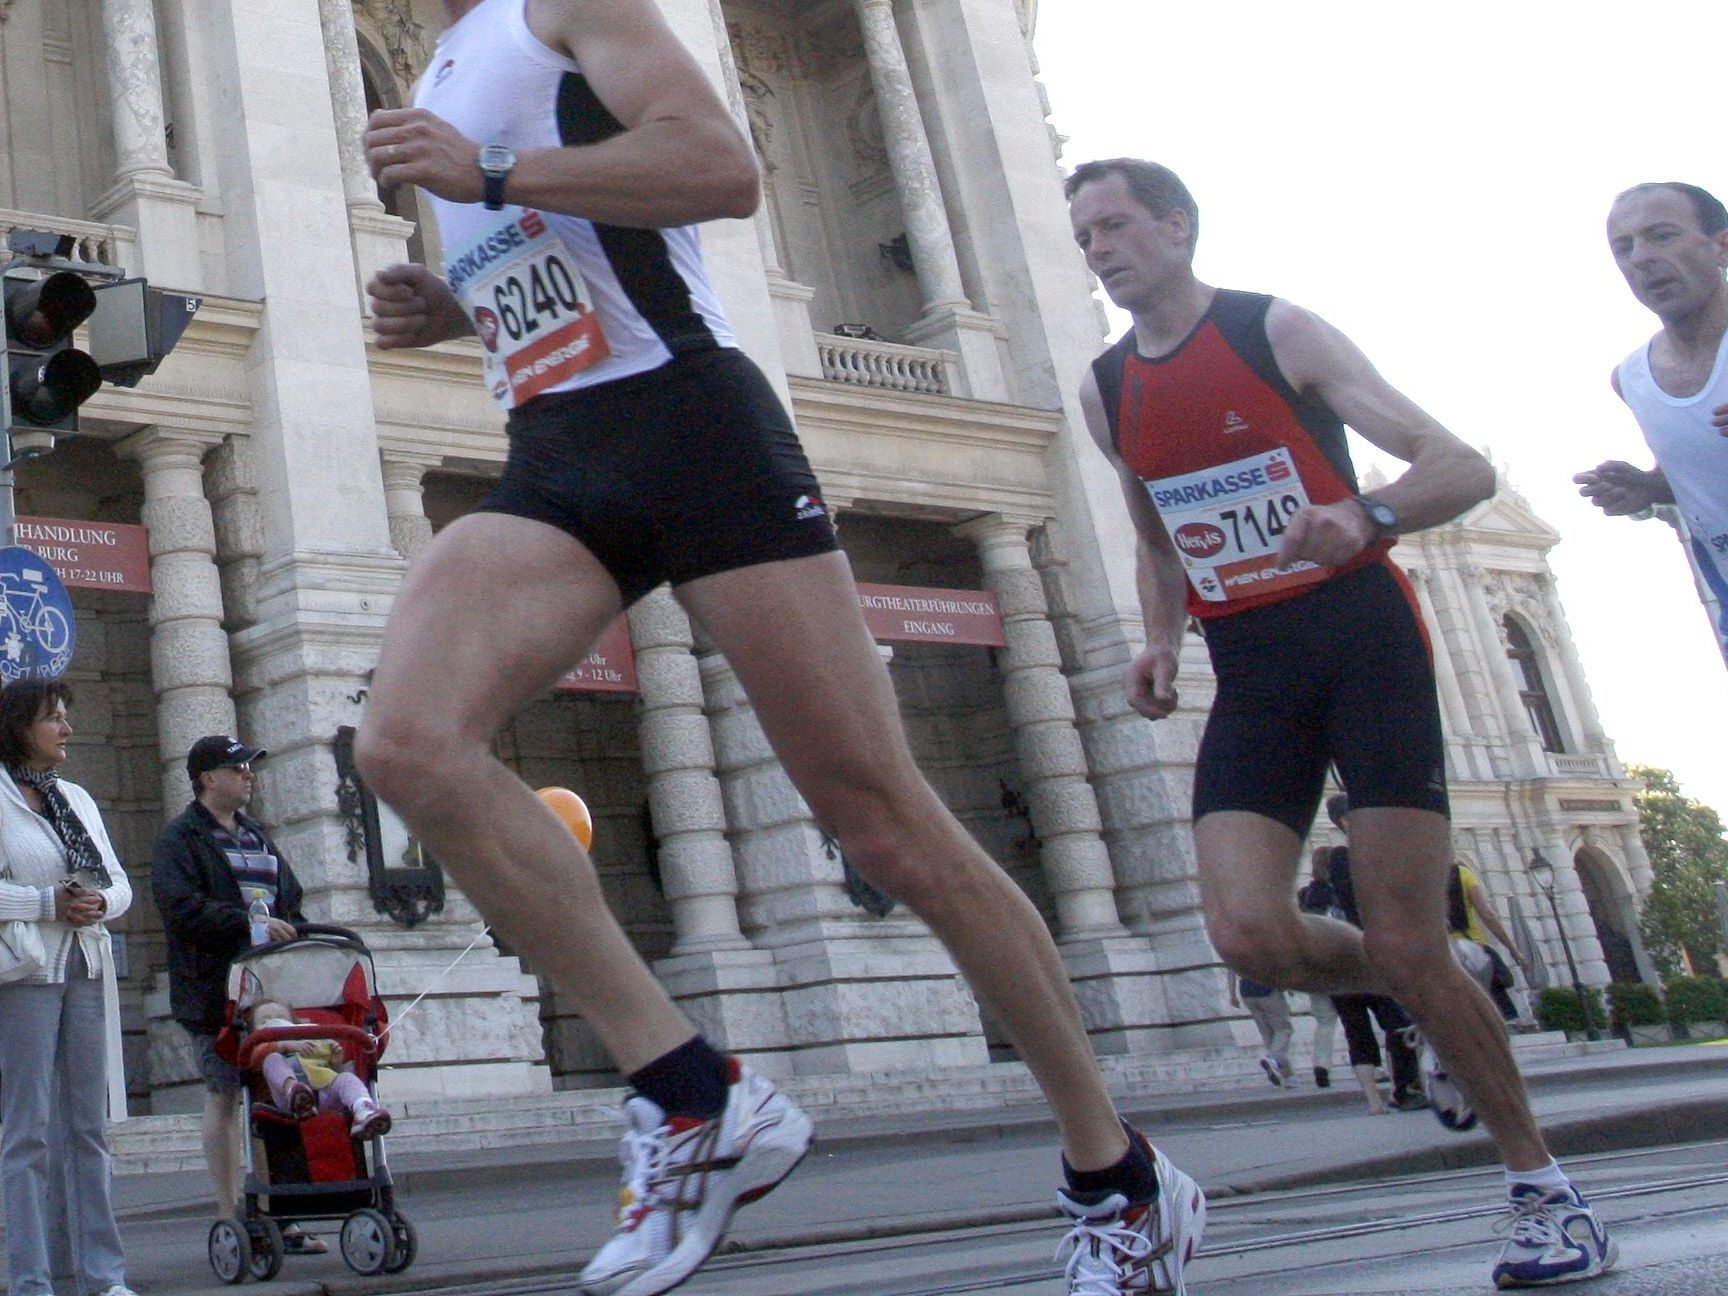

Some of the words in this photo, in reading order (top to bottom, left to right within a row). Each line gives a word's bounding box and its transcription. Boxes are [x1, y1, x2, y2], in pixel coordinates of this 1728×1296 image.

[187, 299, 196, 310] 5
[493, 254, 578, 341] 6240
[1154, 467, 1266, 508] SPARKASSE
[1176, 531, 1222, 550] Hervis
[38, 545, 79, 562] BURG
[69, 568, 97, 583] 17-22
[99, 571, 124, 584] UHR
[860, 594, 995, 616] URGTHEATERFÜHRUNGEN
[904, 620, 955, 635] EINGANG
[592, 669, 604, 681] 12
[604, 669, 622, 682] Uhr
